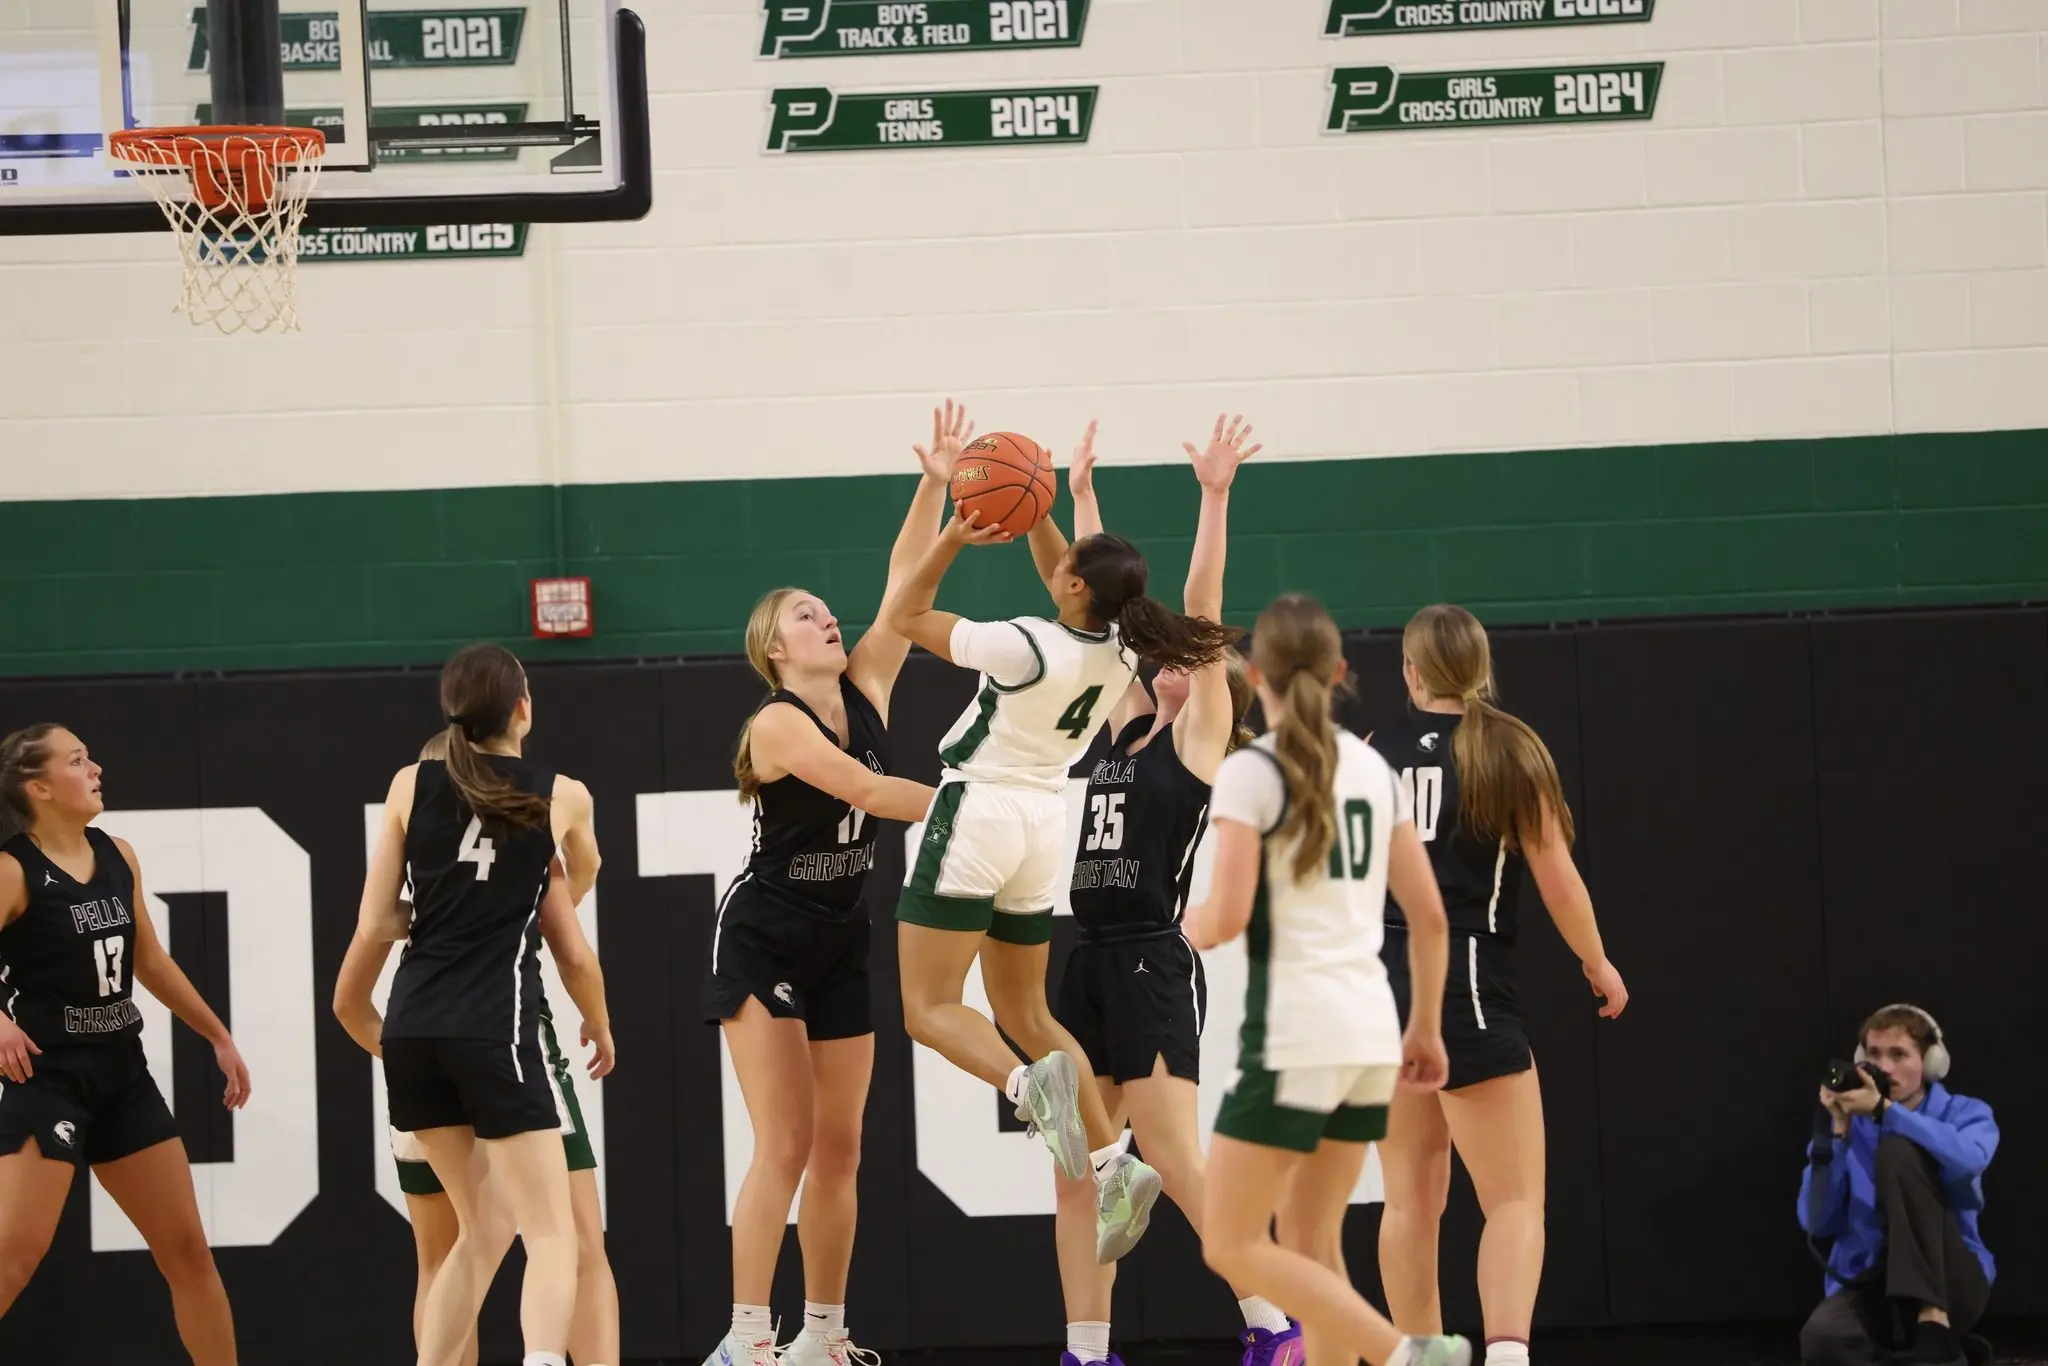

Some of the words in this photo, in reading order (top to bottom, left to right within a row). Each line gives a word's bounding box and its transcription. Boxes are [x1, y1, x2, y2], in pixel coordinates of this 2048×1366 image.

[877, 4, 928, 26] BOYS
[990, 1, 1069, 41] 2021
[1395, 3, 1454, 27] CROSS
[1459, 1, 1545, 24] COUNTRY
[308, 20, 339, 41] BO
[422, 17, 501, 58] 2021
[836, 27, 897, 49] TRACK
[902, 26, 918, 46] &
[923, 24, 970, 46] FIELD
[1447, 77, 1497, 100] GIRLS
[1553, 71, 1643, 115] 2024
[884, 99, 934, 121] GIRLS
[990, 95, 1080, 138] 2024
[1399, 99, 1456, 123] CROSS
[1459, 96, 1543, 120] COUNTRY
[877, 120, 943, 143] TENNIS
[332, 231, 417, 254] COUNTRY
[1055, 685, 1104, 740] 4
[1086, 793, 1126, 852] 35
[457, 813, 496, 881] 4
[70, 896, 131, 934] PELLA
[93, 935, 125, 998] 13
